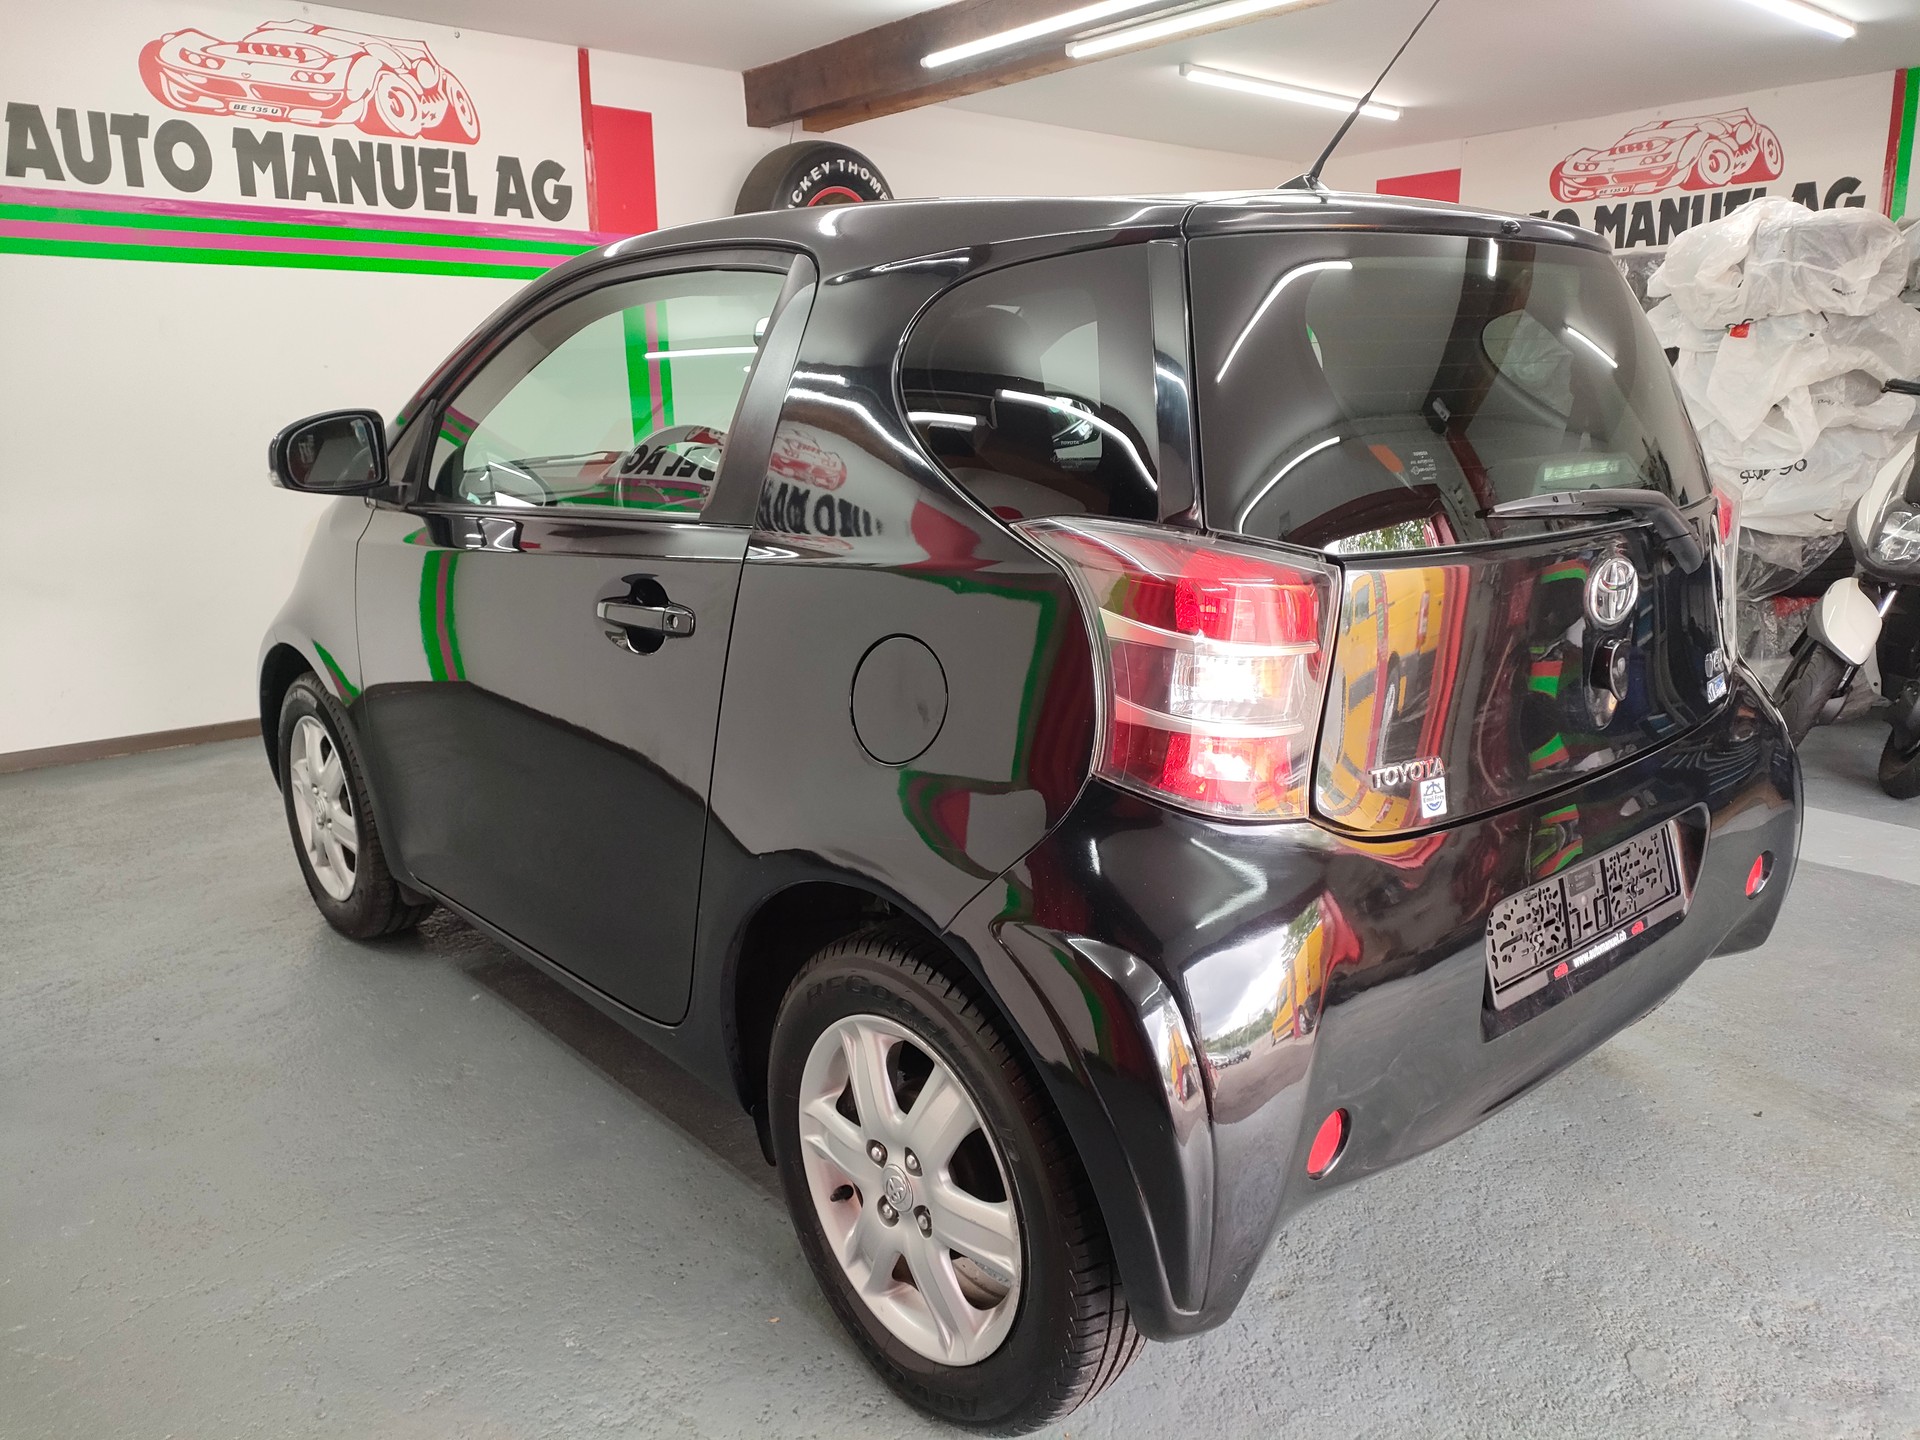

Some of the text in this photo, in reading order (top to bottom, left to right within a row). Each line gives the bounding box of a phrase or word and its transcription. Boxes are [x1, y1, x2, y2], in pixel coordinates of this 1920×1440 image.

[233, 103, 248, 111] BE
[5, 102, 573, 222] AUTO MANUEL AG
[788, 161, 830, 208] CKEY
[1594, 187, 1767, 250] MANU
[1370, 757, 1446, 788] TOYOTA
